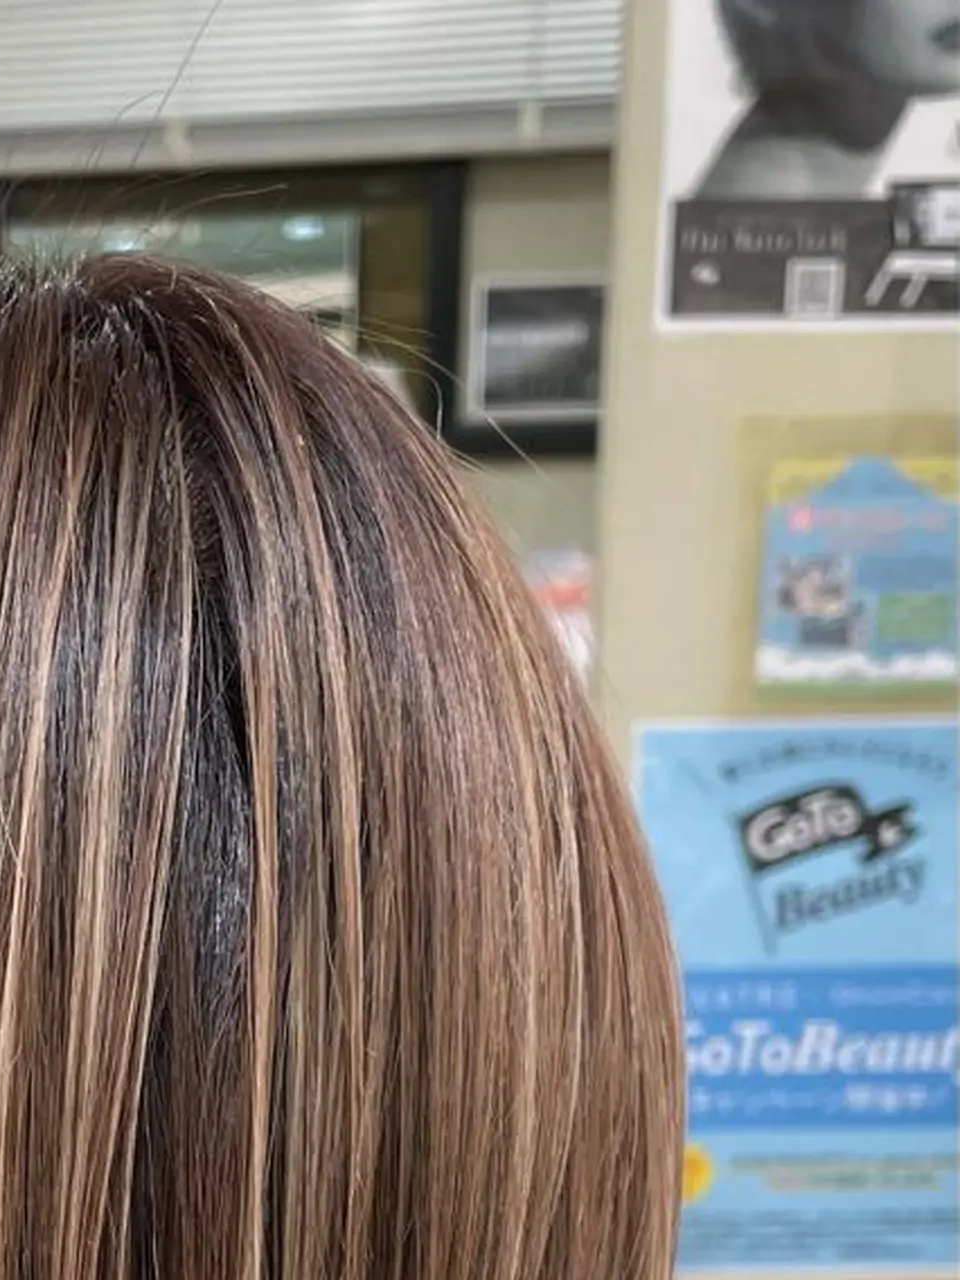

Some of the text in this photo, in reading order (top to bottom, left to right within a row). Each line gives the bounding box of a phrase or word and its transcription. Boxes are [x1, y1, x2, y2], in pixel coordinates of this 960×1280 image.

[746, 790, 863, 863] GoTo
[776, 858, 927, 932] Beauty
[685, 1018, 959, 1087] oToBeaut
